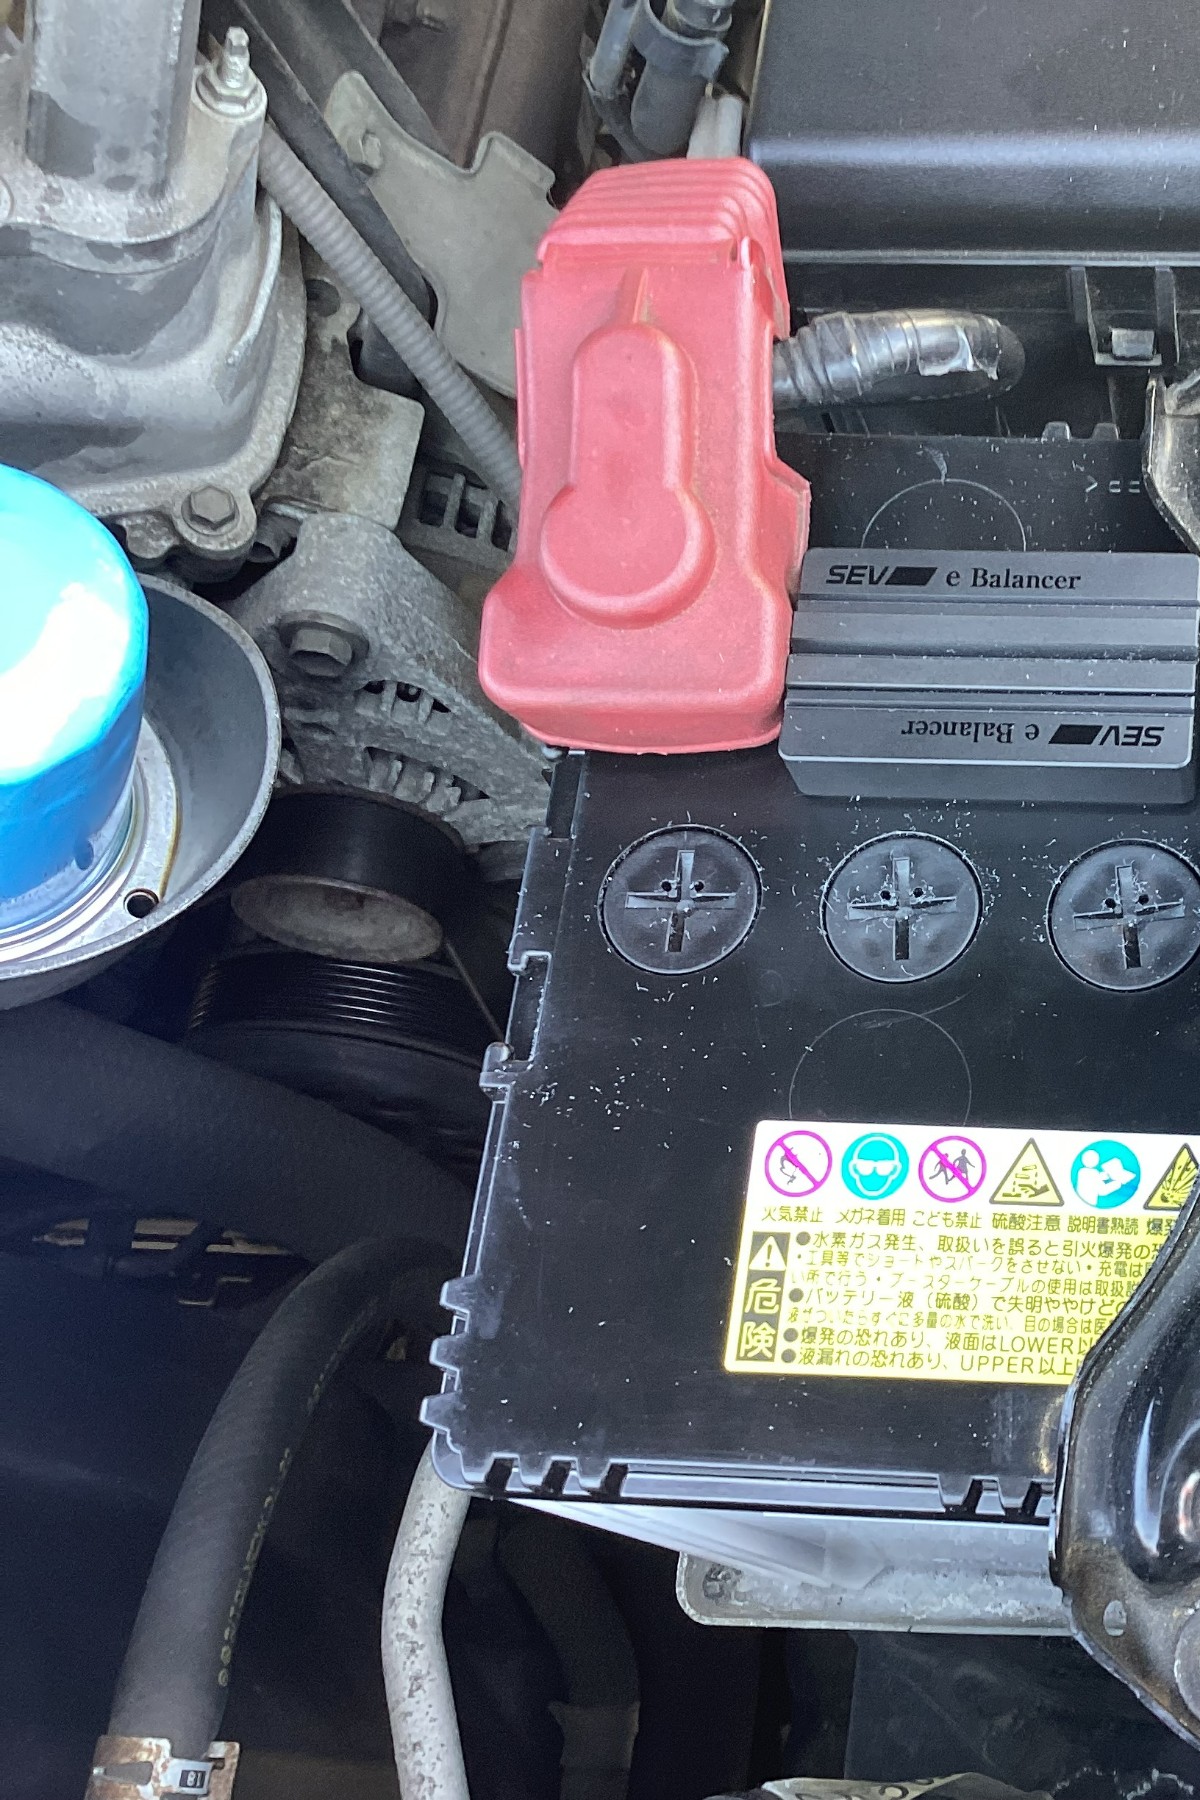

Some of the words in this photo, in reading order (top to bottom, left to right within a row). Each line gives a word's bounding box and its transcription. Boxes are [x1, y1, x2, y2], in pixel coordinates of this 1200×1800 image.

[826, 564, 888, 586] SEV
[946, 569, 960, 587] e
[970, 566, 1081, 590] Balancer
[900, 719, 1015, 744] Balancer
[1024, 723, 1041, 741] e
[1098, 725, 1165, 747] SEV
[761, 1205, 824, 1223] 火気禁止
[835, 1207, 906, 1227] メガネ着用
[912, 1210, 983, 1230] こども禁止
[991, 1211, 1061, 1232] 硫酸注意
[1067, 1214, 1139, 1236] 説明書熟読
[739, 1277, 782, 1359] 危険
